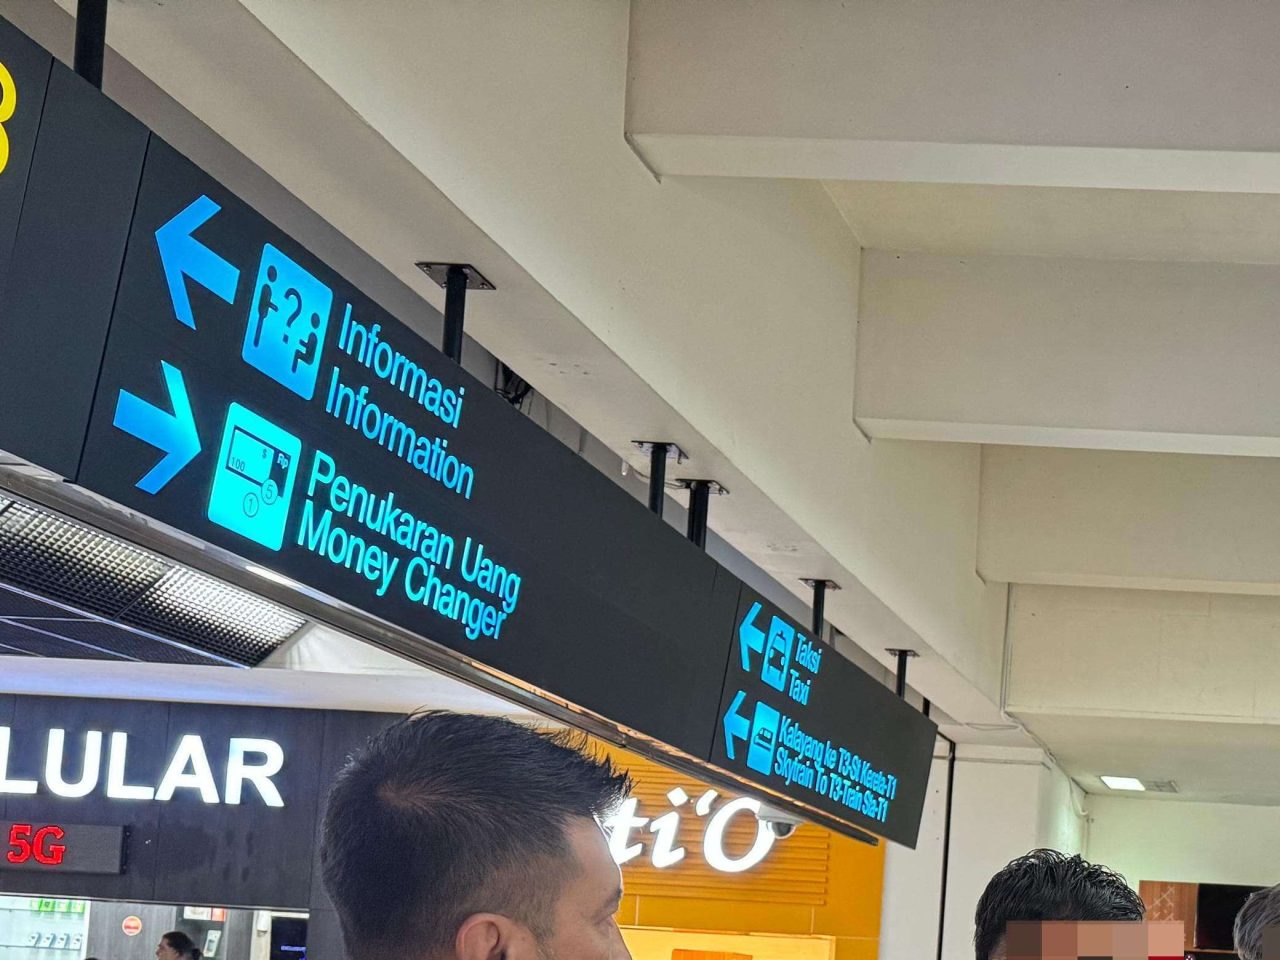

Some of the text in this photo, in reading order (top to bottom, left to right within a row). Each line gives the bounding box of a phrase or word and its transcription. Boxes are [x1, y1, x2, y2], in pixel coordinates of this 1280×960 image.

[338, 303, 466, 428] Informasi
[325, 366, 475, 499] Information
[307, 450, 521, 612] Penukaran Uang
[298, 499, 508, 640] Money Changer
[797, 632, 822, 674] Taksi
[788, 669, 811, 705] Taxi
[778, 715, 824, 765] Kalayang
[823, 740, 837, 770] ke
[774, 746, 812, 786] Skytrain
[815, 767, 829, 795] To
[7, 823, 67, 865] 5G
